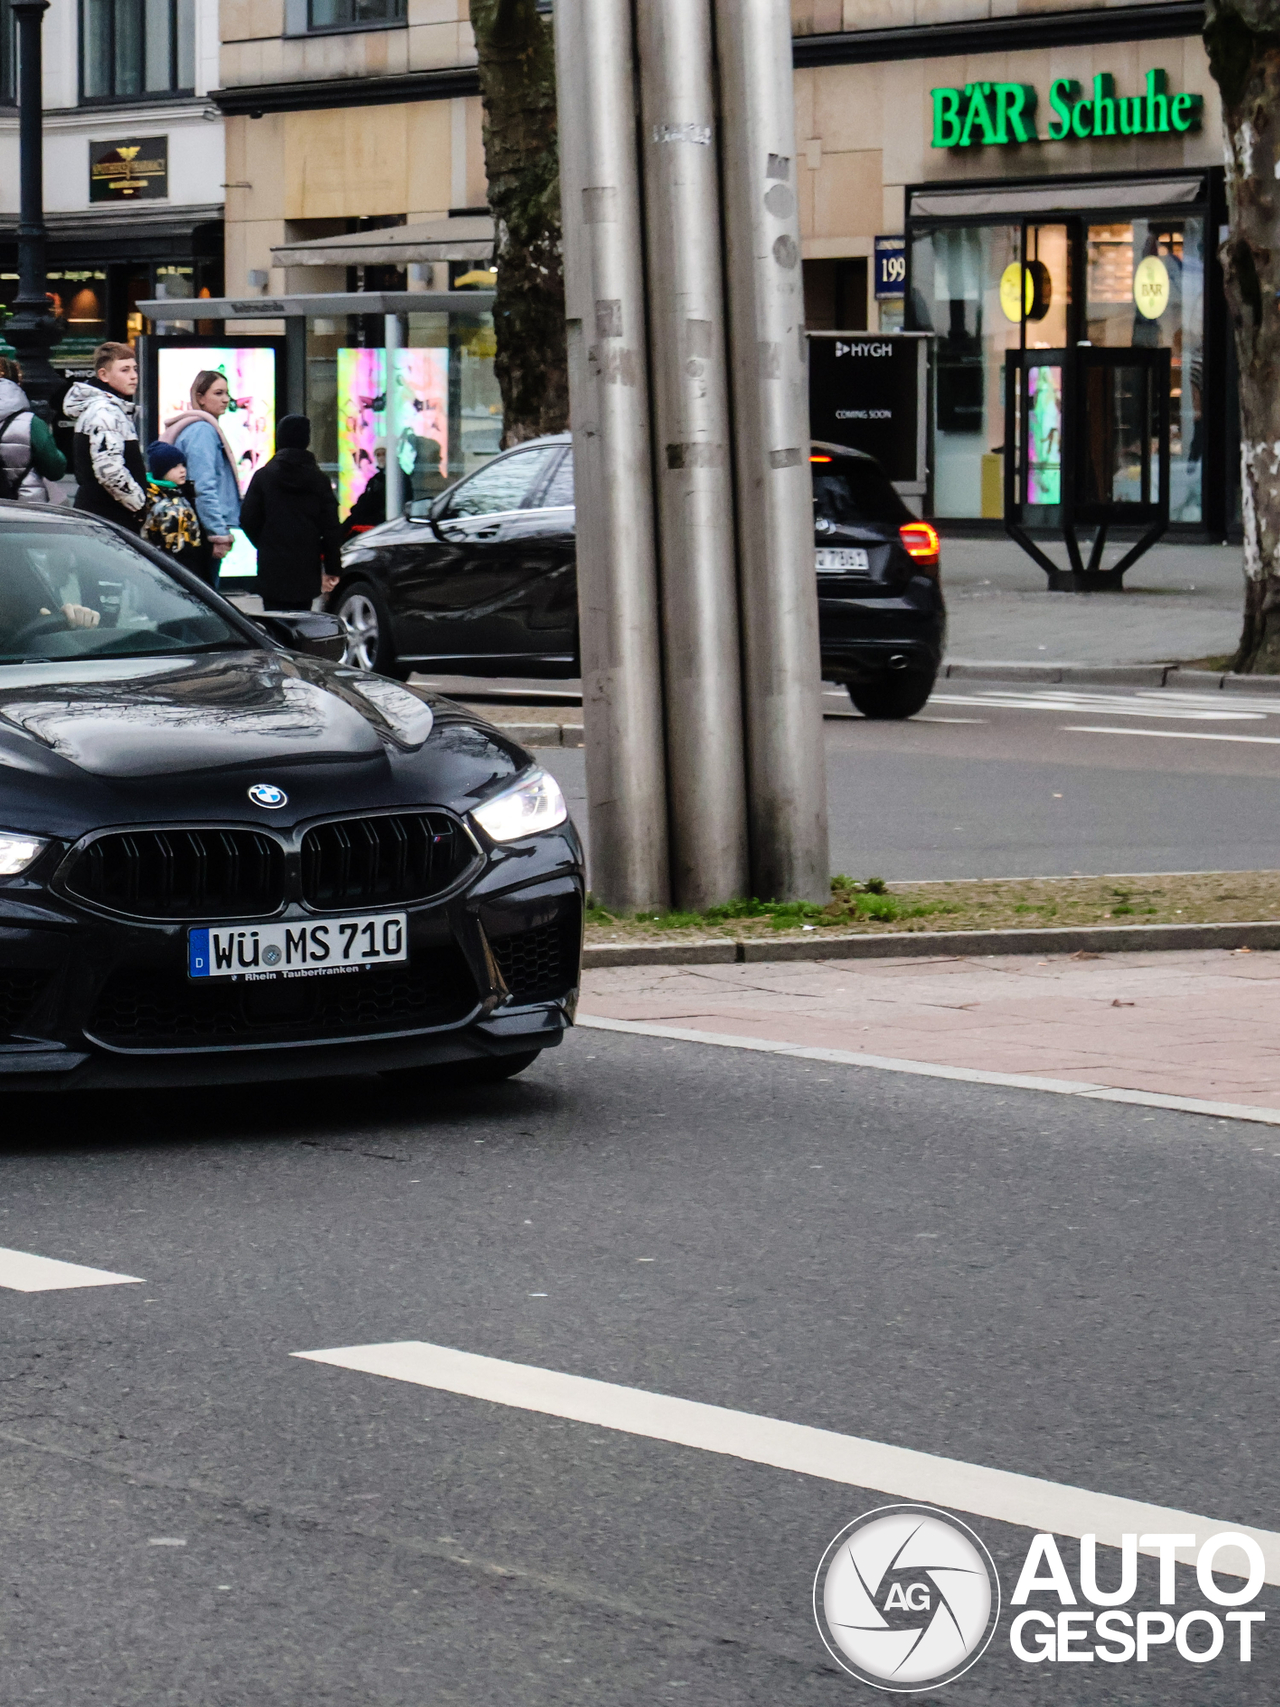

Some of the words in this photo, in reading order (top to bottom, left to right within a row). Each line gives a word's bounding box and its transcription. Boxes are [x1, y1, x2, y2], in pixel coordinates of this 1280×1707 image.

[931, 81, 1030, 148] BÄR
[1048, 68, 1198, 140] Schuhe
[882, 257, 906, 283] 199
[851, 343, 893, 357] HYGH
[835, 410, 868, 419] COMING
[869, 410, 893, 419] SOON
[213, 931, 260, 969] WÜ
[285, 925, 331, 964] MS
[339, 919, 402, 960] 710
[195, 957, 205, 969] D
[244, 971, 277, 983] Rhein
[281, 964, 360, 979] Tauberfranken
